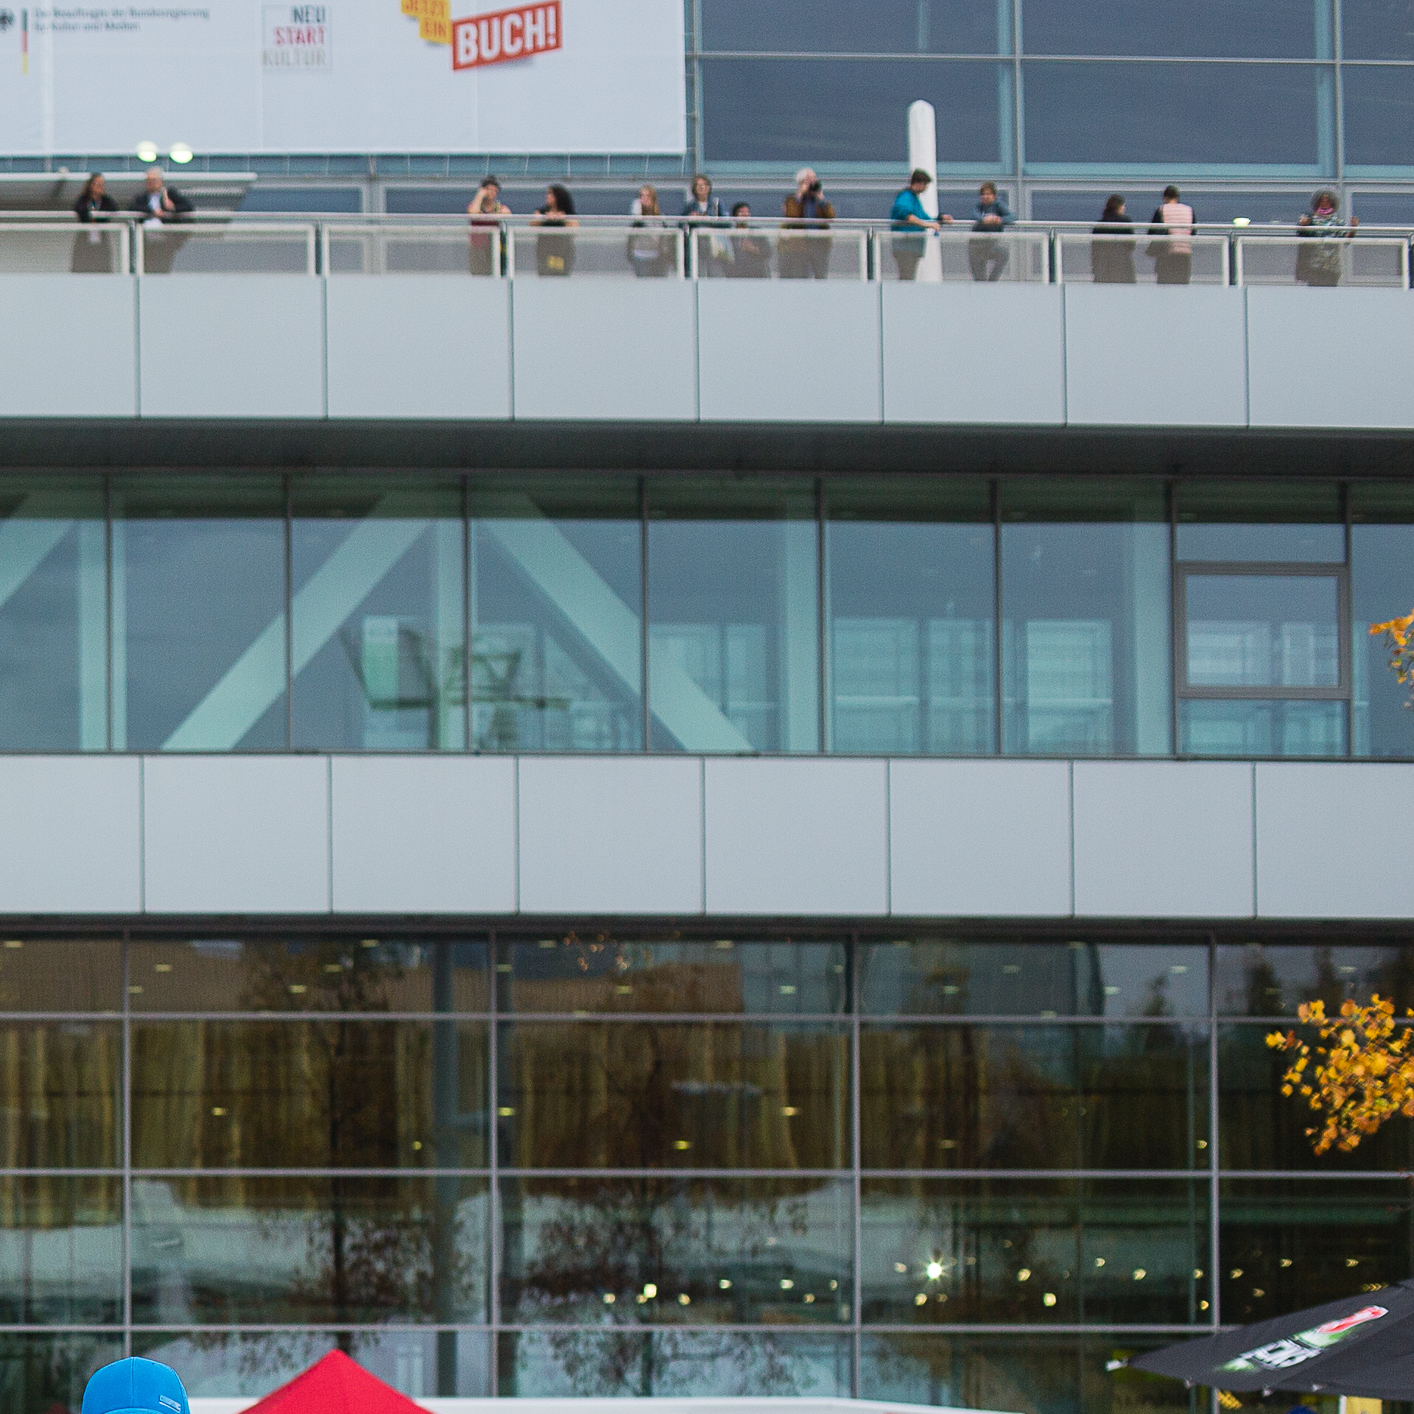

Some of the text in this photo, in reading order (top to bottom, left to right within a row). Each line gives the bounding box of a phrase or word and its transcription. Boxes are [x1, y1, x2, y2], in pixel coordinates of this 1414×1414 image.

[293, 5, 326, 24] NEU
[275, 26, 326, 46] START
[457, 5, 558, 65] BUCH!
